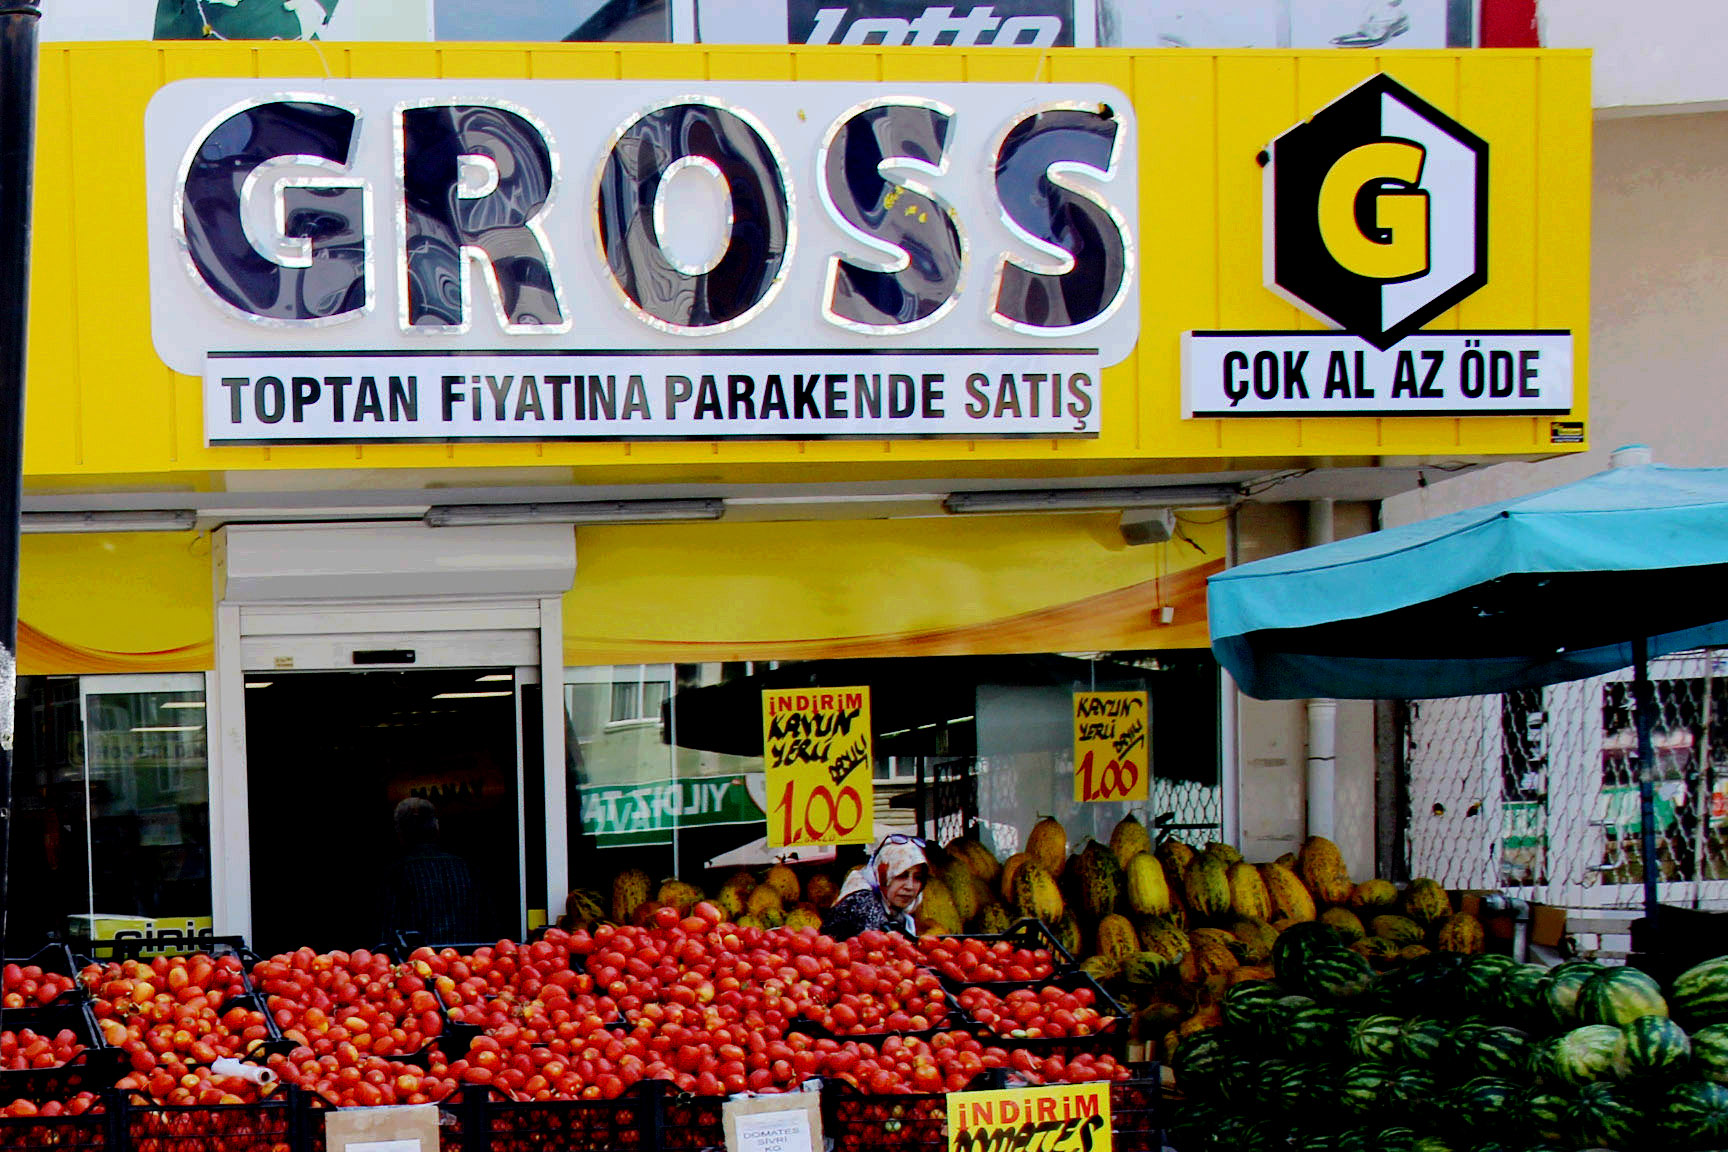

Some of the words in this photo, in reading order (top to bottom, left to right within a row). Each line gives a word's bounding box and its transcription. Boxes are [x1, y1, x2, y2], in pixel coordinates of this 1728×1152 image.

[171, 91, 1138, 339] GROSS
[221, 375, 418, 424] TOPTAN
[665, 373, 942, 421] PARAKENDE
[965, 370, 1094, 430] SATIŞ
[1222, 350, 1309, 408] ÇOK
[1323, 349, 1375, 400] AL
[1389, 350, 1446, 400] AZ
[1460, 338, 1541, 400] ÖDE
[1077, 697, 1143, 718] KAVUN
[1075, 750, 1139, 802] 1.00
[743, 1127, 800, 1139] DOMATES
